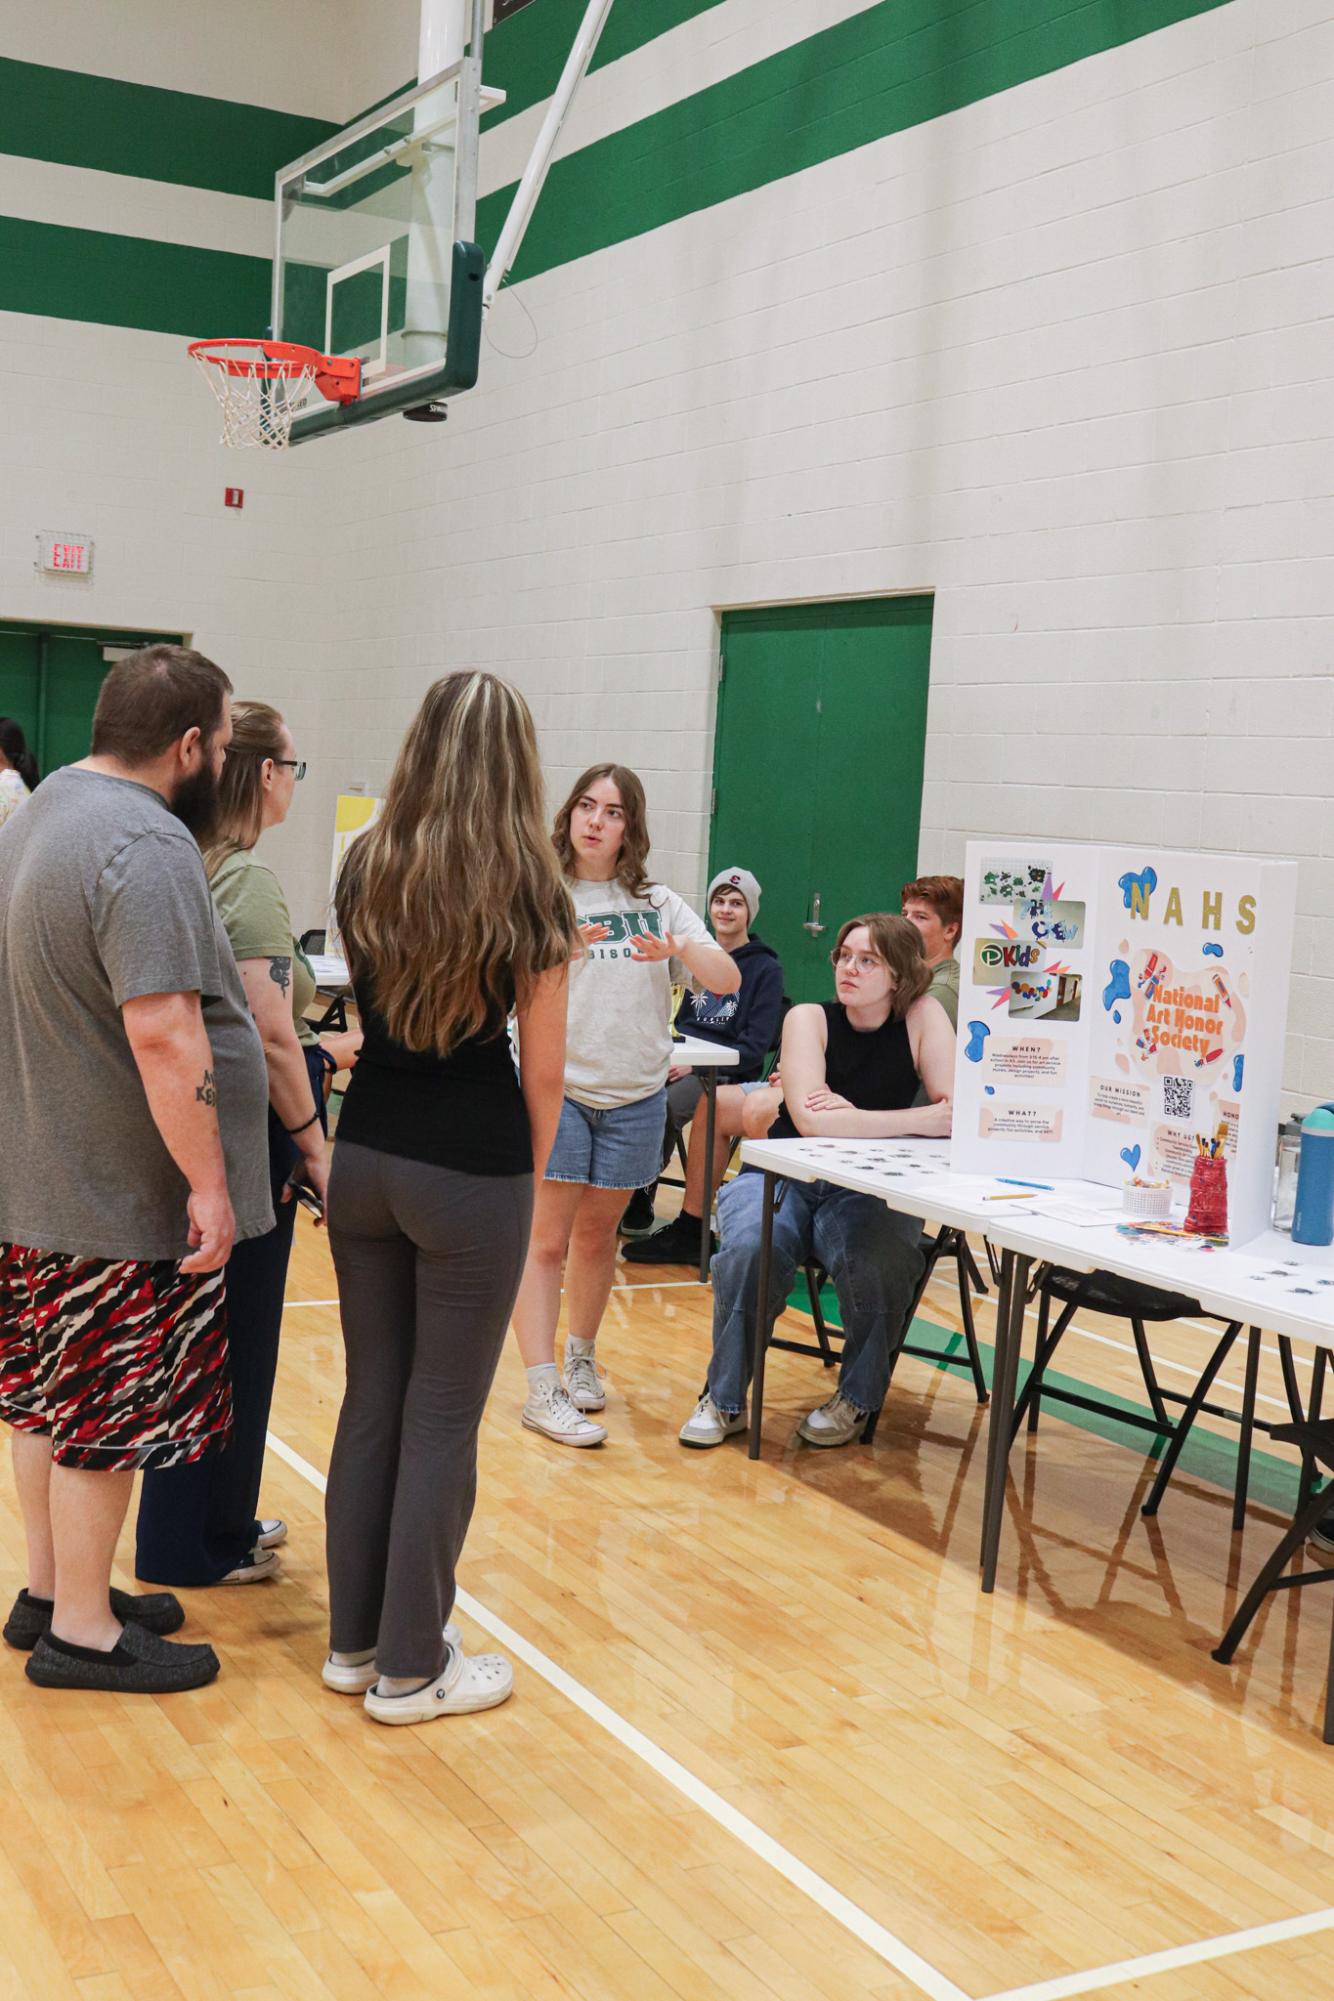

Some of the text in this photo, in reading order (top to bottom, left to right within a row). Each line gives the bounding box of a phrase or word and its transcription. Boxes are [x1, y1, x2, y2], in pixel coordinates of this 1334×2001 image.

[53, 543, 85, 570] EXIT
[1130, 882, 1257, 935] NAHS
[576, 910, 664, 945] BU
[1152, 984, 1221, 1014] National
[1146, 1003, 1224, 1036] Art Honor
[1151, 1025, 1211, 1058] Society
[1115, 1087, 1141, 1097] MISSION
